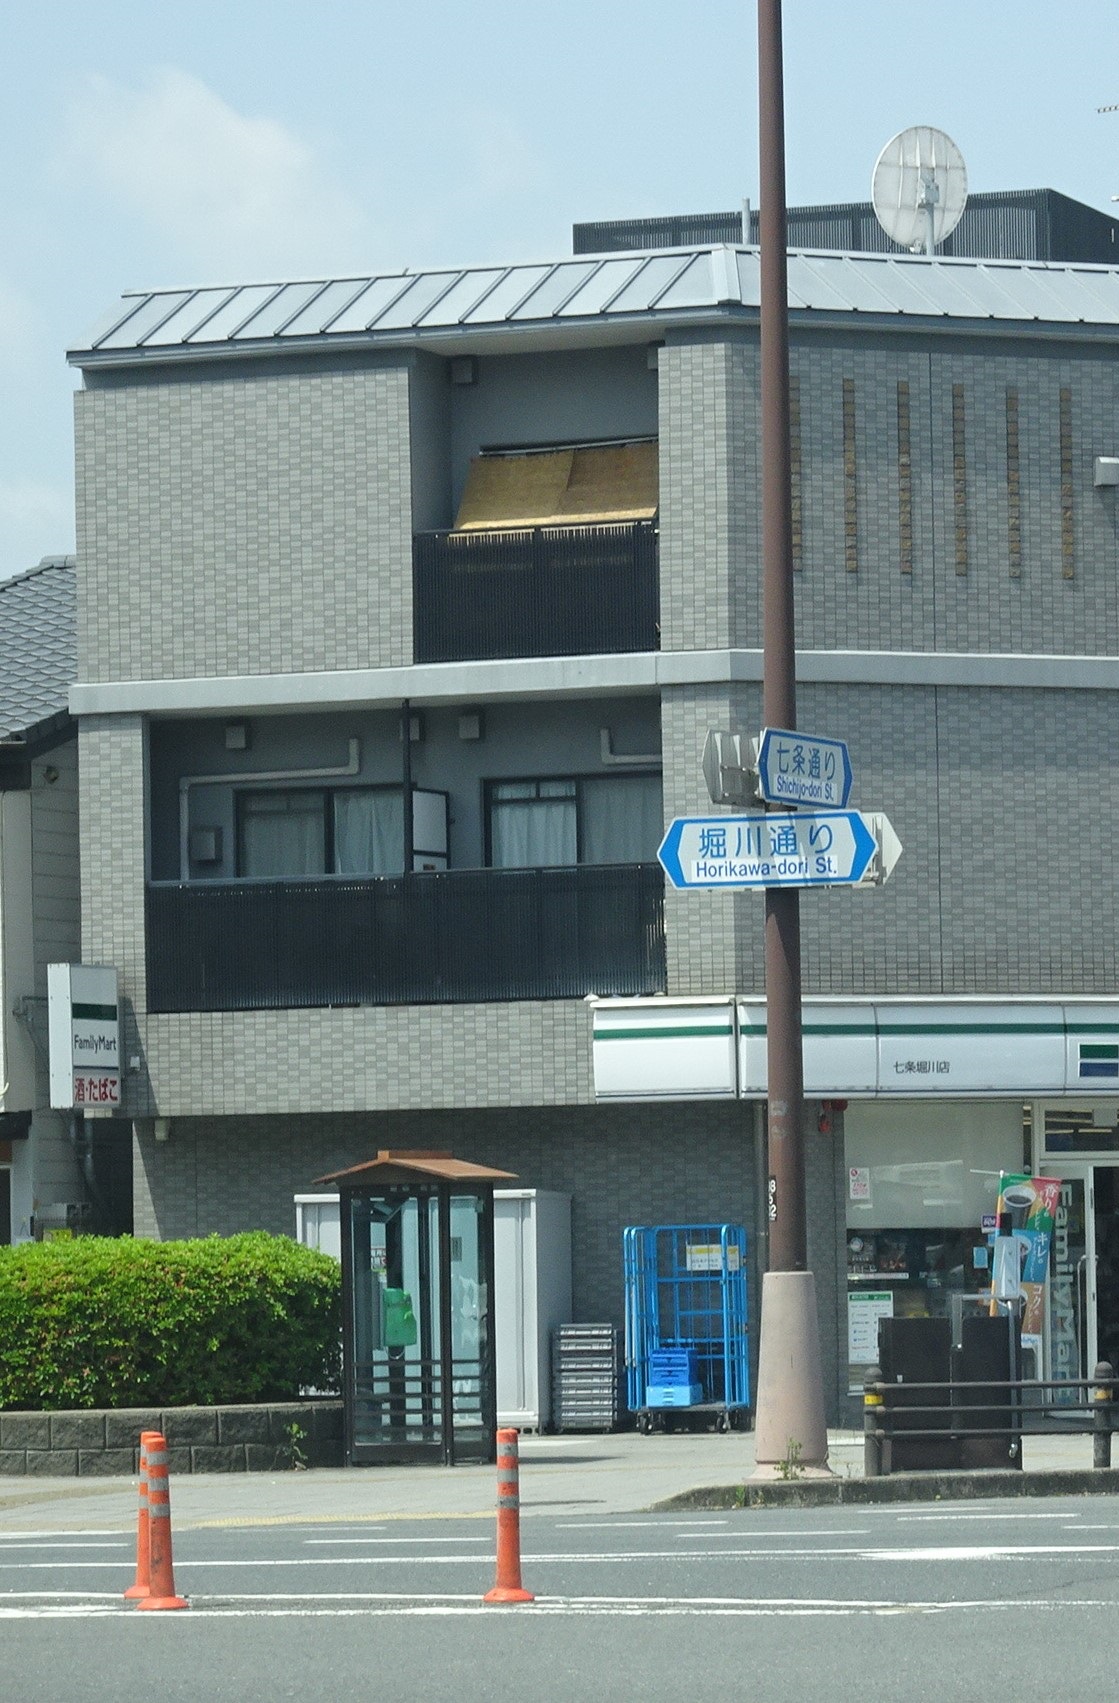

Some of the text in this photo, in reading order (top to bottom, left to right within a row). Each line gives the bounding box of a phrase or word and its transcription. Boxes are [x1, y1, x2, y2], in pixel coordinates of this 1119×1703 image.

[776, 741, 836, 781] 七条通り
[776, 774, 823, 799] Shichijo-dori
[699, 824, 834, 859] 堀川通り
[696, 857, 838, 878] Horikawa-dori St.
[74, 1034, 117, 1054] FamilyMart
[893, 1060, 951, 1074] 七条堀川店
